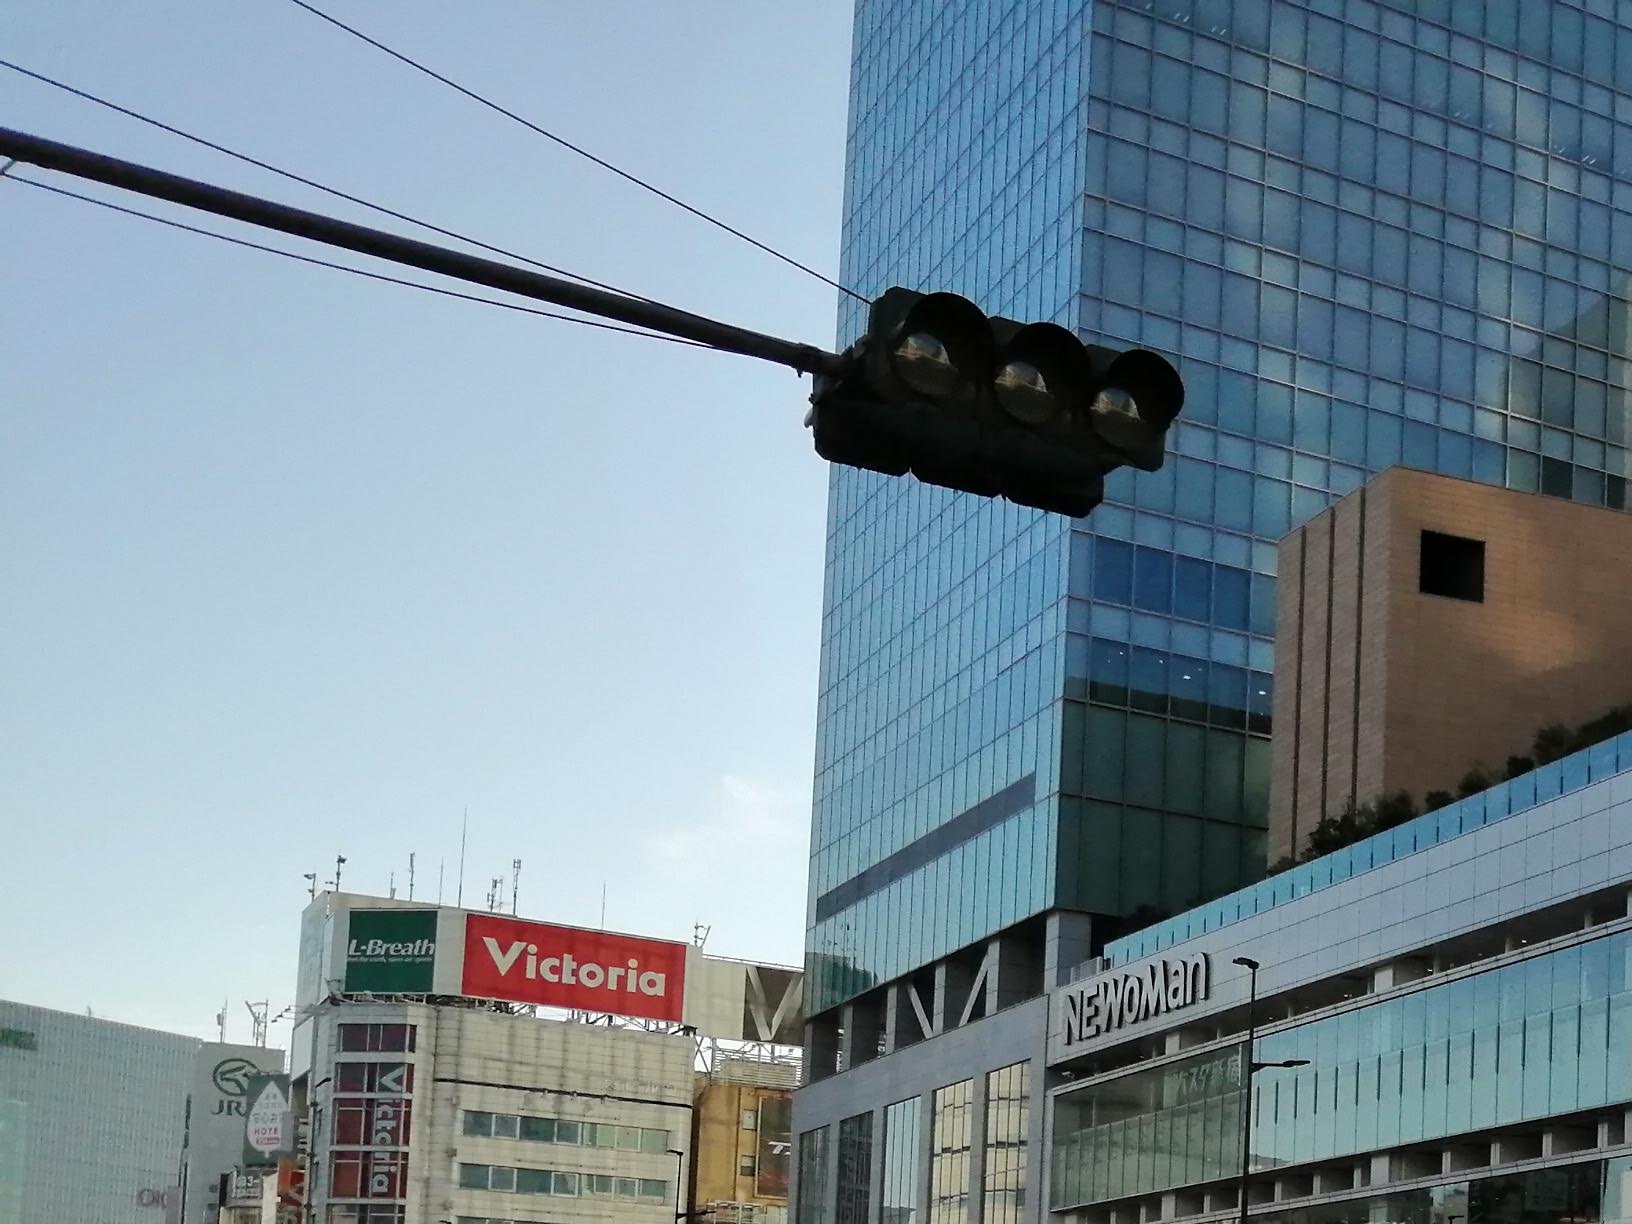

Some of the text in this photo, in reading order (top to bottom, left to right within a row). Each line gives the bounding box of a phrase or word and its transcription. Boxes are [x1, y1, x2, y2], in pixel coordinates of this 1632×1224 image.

[481, 936, 667, 997] Victoria
[210, 1099, 248, 1117] JR
[371, 1065, 404, 1194] Victoria
